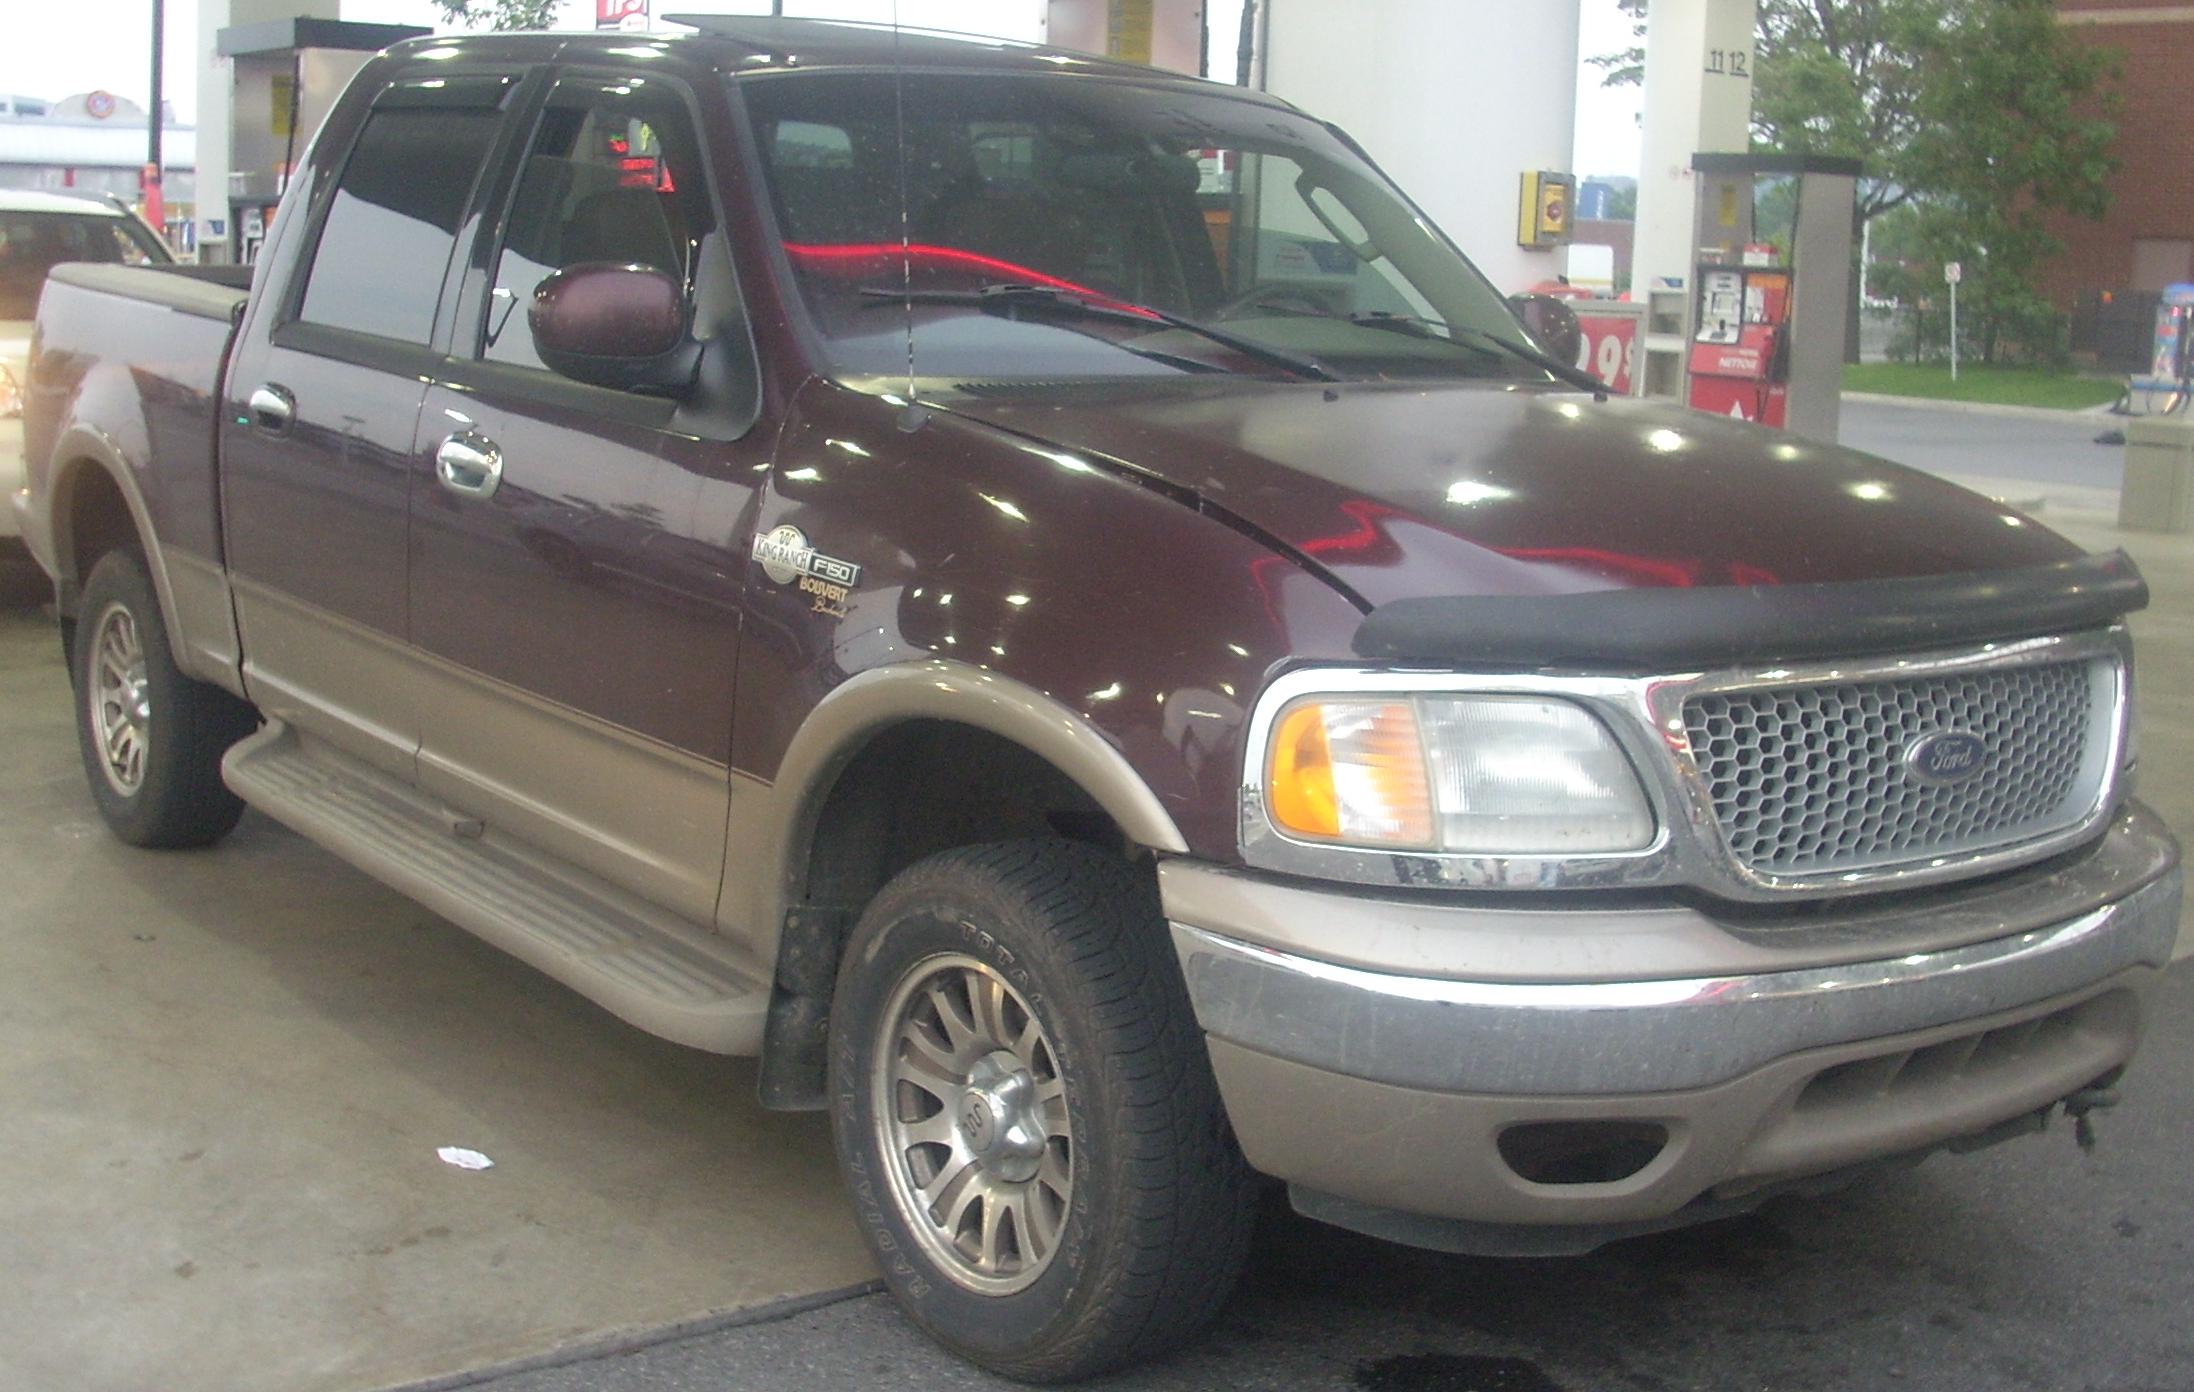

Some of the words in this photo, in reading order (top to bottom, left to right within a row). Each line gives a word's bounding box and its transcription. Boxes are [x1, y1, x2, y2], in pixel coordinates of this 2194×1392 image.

[1708, 49, 1724, 73] 11
[1729, 51, 1747, 76] 12
[777, 546, 809, 570] RANCH
[1930, 740, 1973, 771] Ford
